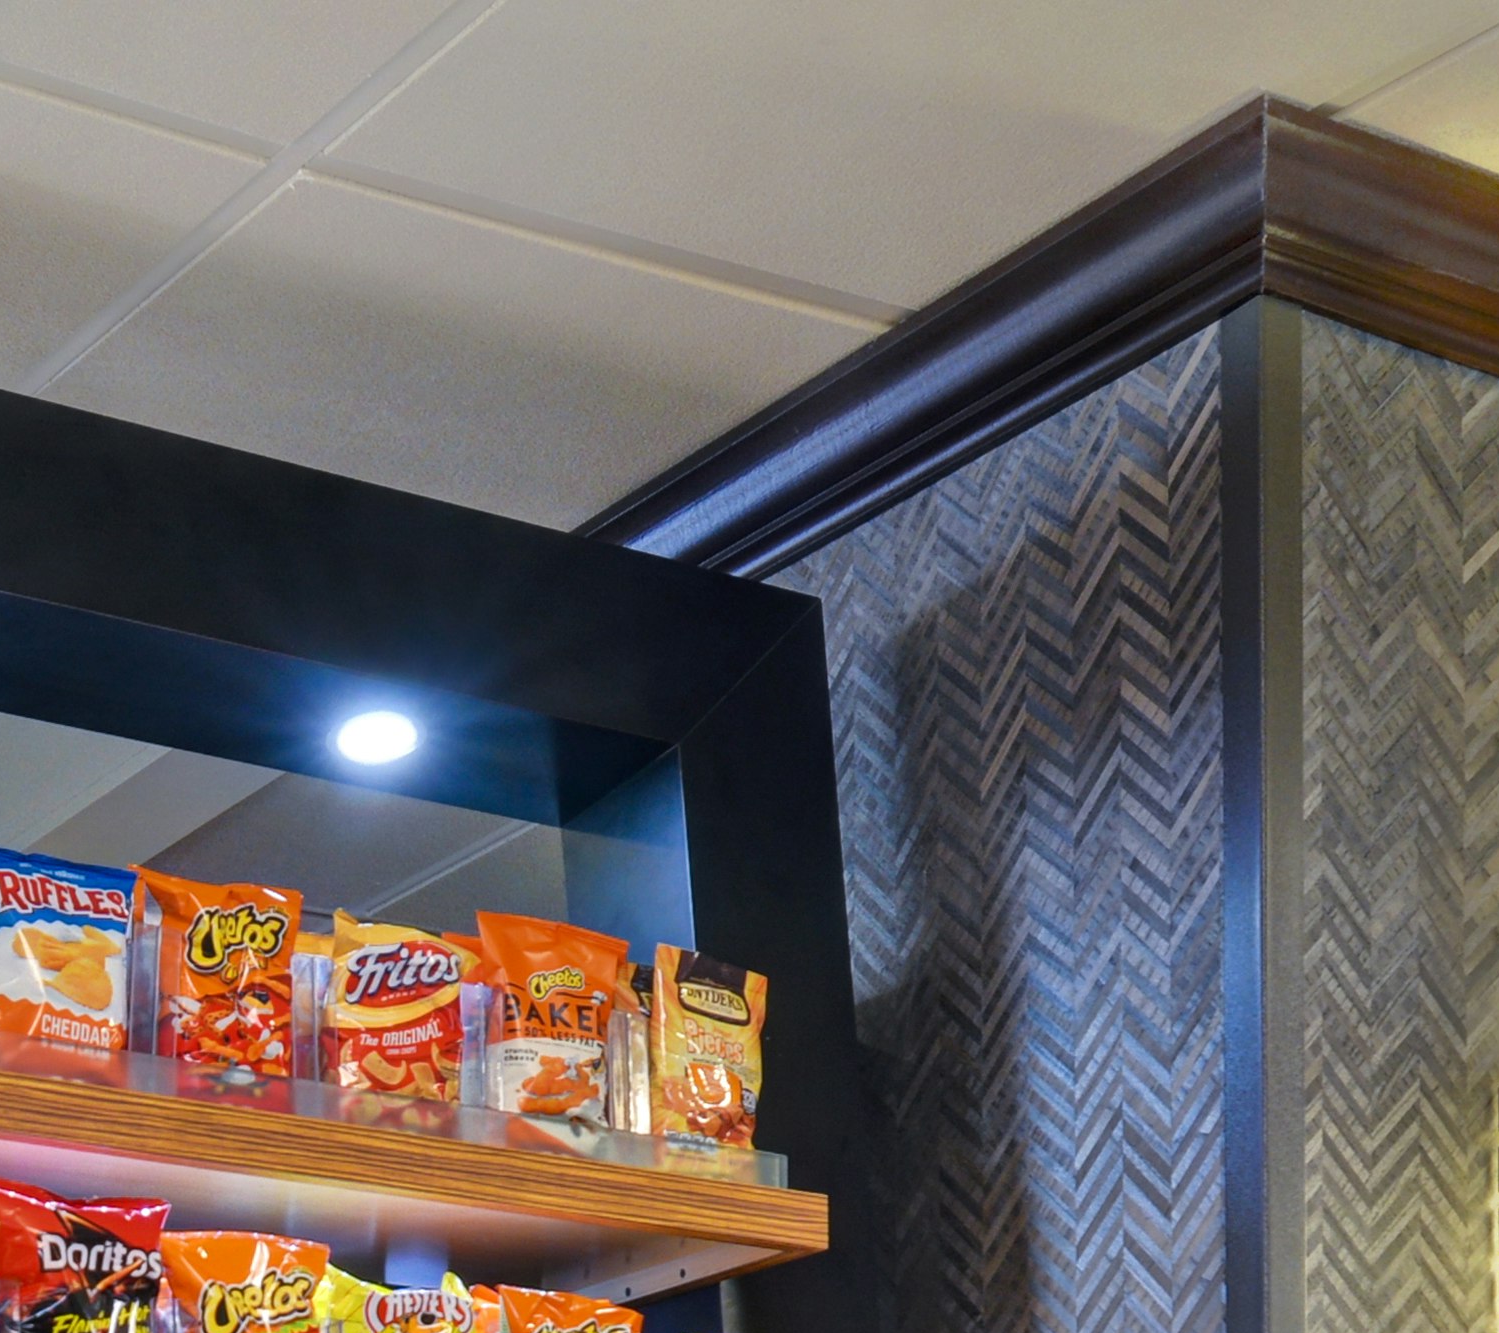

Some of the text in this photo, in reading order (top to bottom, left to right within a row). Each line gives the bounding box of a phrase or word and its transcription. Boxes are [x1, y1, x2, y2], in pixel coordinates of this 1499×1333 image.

[346, 943, 460, 1003] Fritos
[529, 966, 584, 1001] Cheetos
[41, 1013, 111, 1047] CHEDDAR
[382, 1020, 444, 1047] ORIGINAL
[40, 1231, 163, 1280] Doritos
